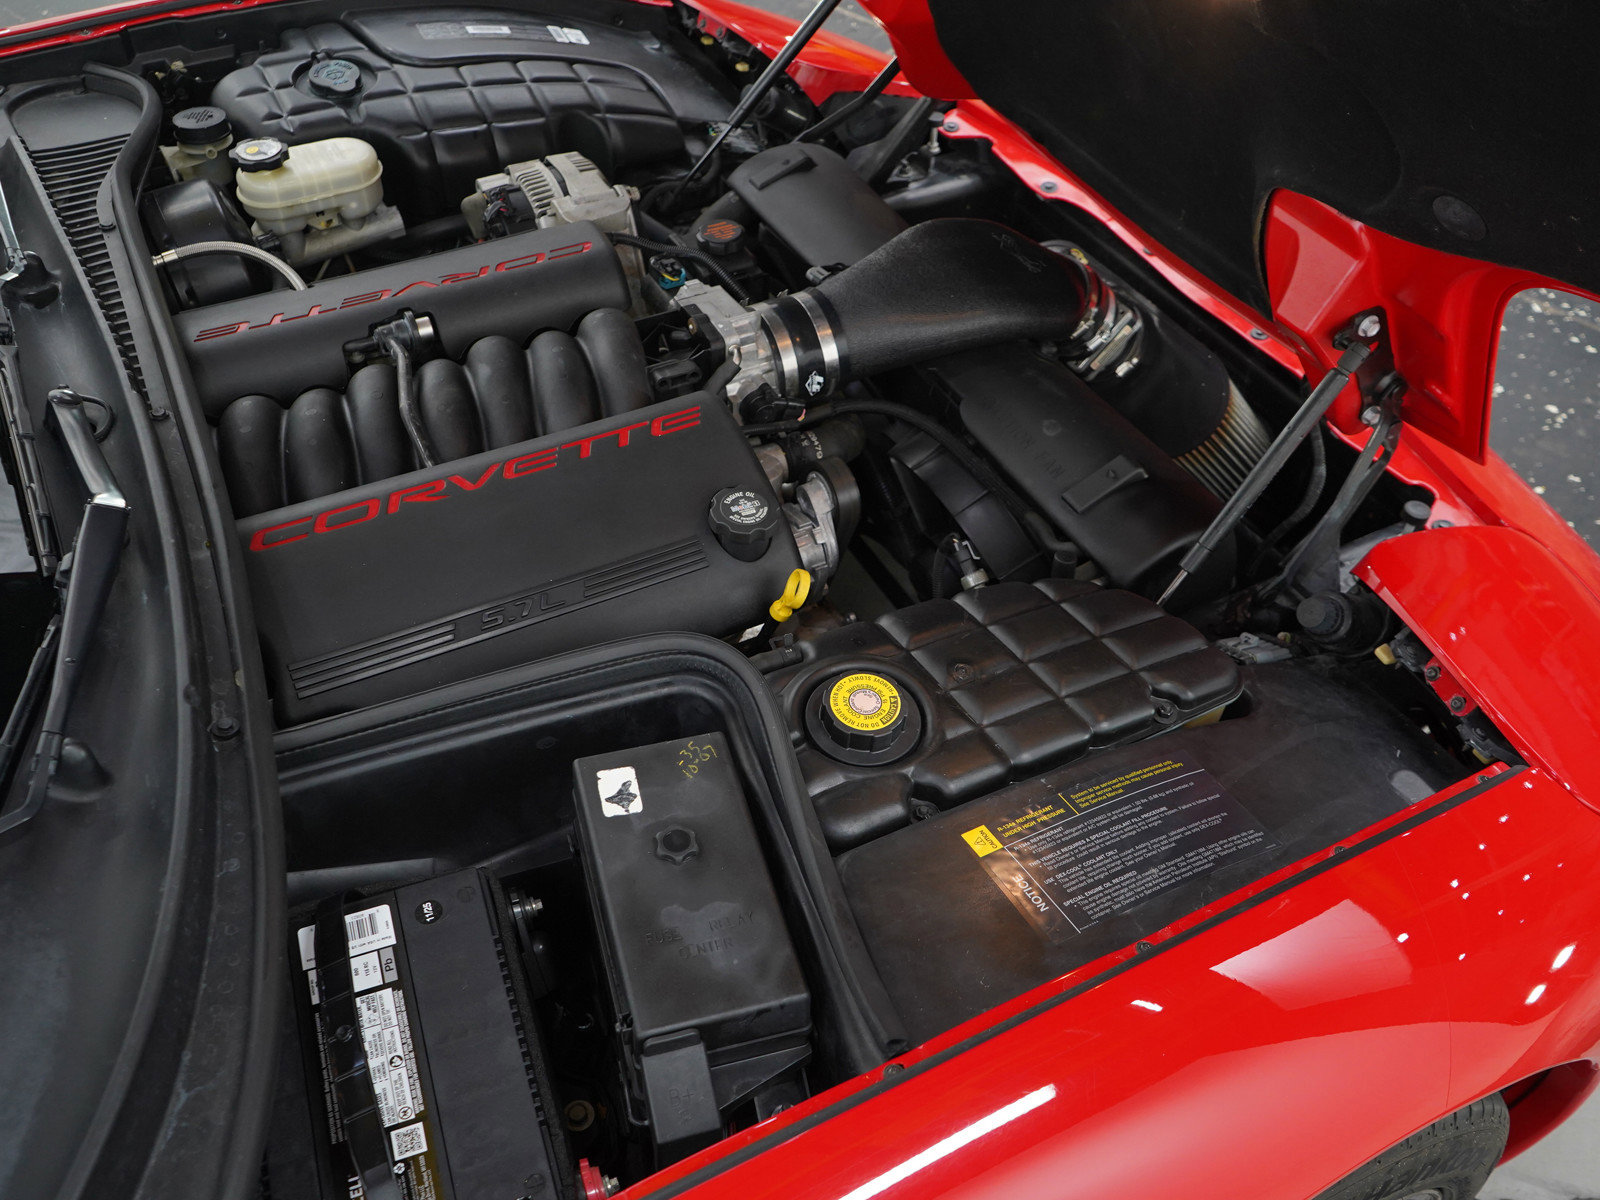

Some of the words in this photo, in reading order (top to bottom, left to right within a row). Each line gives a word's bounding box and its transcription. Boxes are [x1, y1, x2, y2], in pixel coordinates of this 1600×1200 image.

[194, 241, 593, 343] CORVETTE
[249, 405, 704, 554] CORVETTE
[724, 491, 744, 504] ENGINE
[481, 592, 566, 631] 5.7L
[836, 682, 844, 692] HOT
[845, 683, 877, 694] PRESSURE
[848, 675, 871, 683] SLOWLY
[873, 677, 893, 692] REMOVE
[834, 707, 855, 725] REMOVE
[842, 696, 861, 718] COOLANT
[863, 708, 886, 720] ENGINE
[997, 822, 1015, 831] R-134a
[1016, 806, 1054, 823] REFRIGERANT
[1003, 827, 1023, 837] UNDER
[1022, 821, 1037, 829] HIGH
[1037, 809, 1066, 822] PRESSURE
[979, 829, 997, 849] CAUTION
[1014, 841, 1030, 849] R-134a
[1030, 827, 1064, 843] REFRIGERANT
[1040, 851, 1061, 861] VEHICLE
[1061, 840, 1086, 852] REQUIRES
[1090, 830, 1110, 840] SPECIAL
[1110, 821, 1132, 831] COOLANT
[1141, 807, 1167, 818] PROCEDURE
[1083, 855, 1105, 866] COOLANT
[1011, 874, 1049, 912] NOTICE
[1063, 894, 1085, 905] SPECIAL
[1085, 886, 1104, 896] ENGINE
[1112, 871, 1137, 883] REQUIRED
[422, 902, 435, 922] 11/25
[645, 927, 683, 945] FUSE
[708, 910, 754, 932] RELAY
[678, 937, 734, 959] CENTER
[383, 957, 393, 972] Pb
